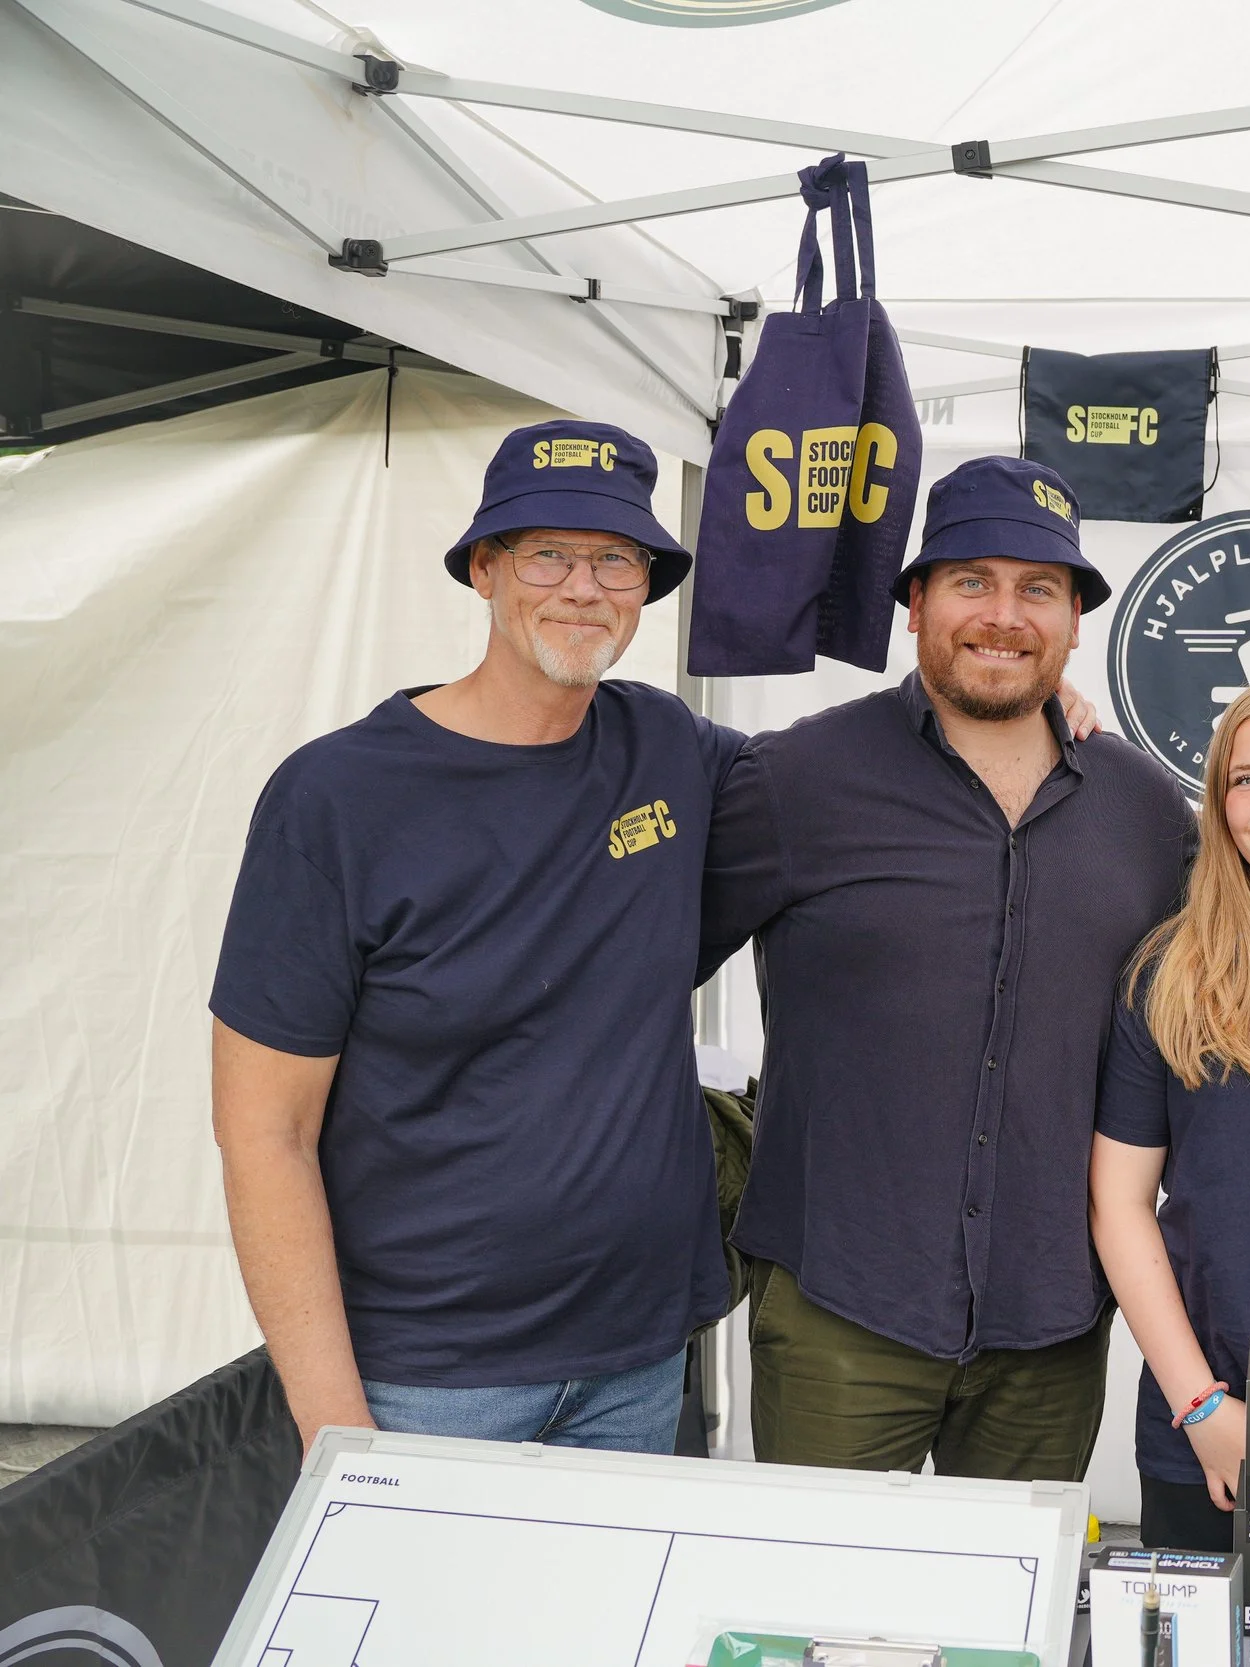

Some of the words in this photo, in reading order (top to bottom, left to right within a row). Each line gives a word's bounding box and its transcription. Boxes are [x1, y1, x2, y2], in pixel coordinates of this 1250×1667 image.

[1091, 412, 1128, 420] STOCKHOLM
[554, 443, 589, 451] STOCKHOLM
[807, 492, 840, 513] CUP
[1168, 731, 1188, 752] VI
[622, 823, 647, 839] FOOTBALL
[1187, 1411, 1205, 1423] CUP
[340, 1473, 400, 1487] FOOTBALL
[1158, 1560, 1220, 1570] TOPUMP
